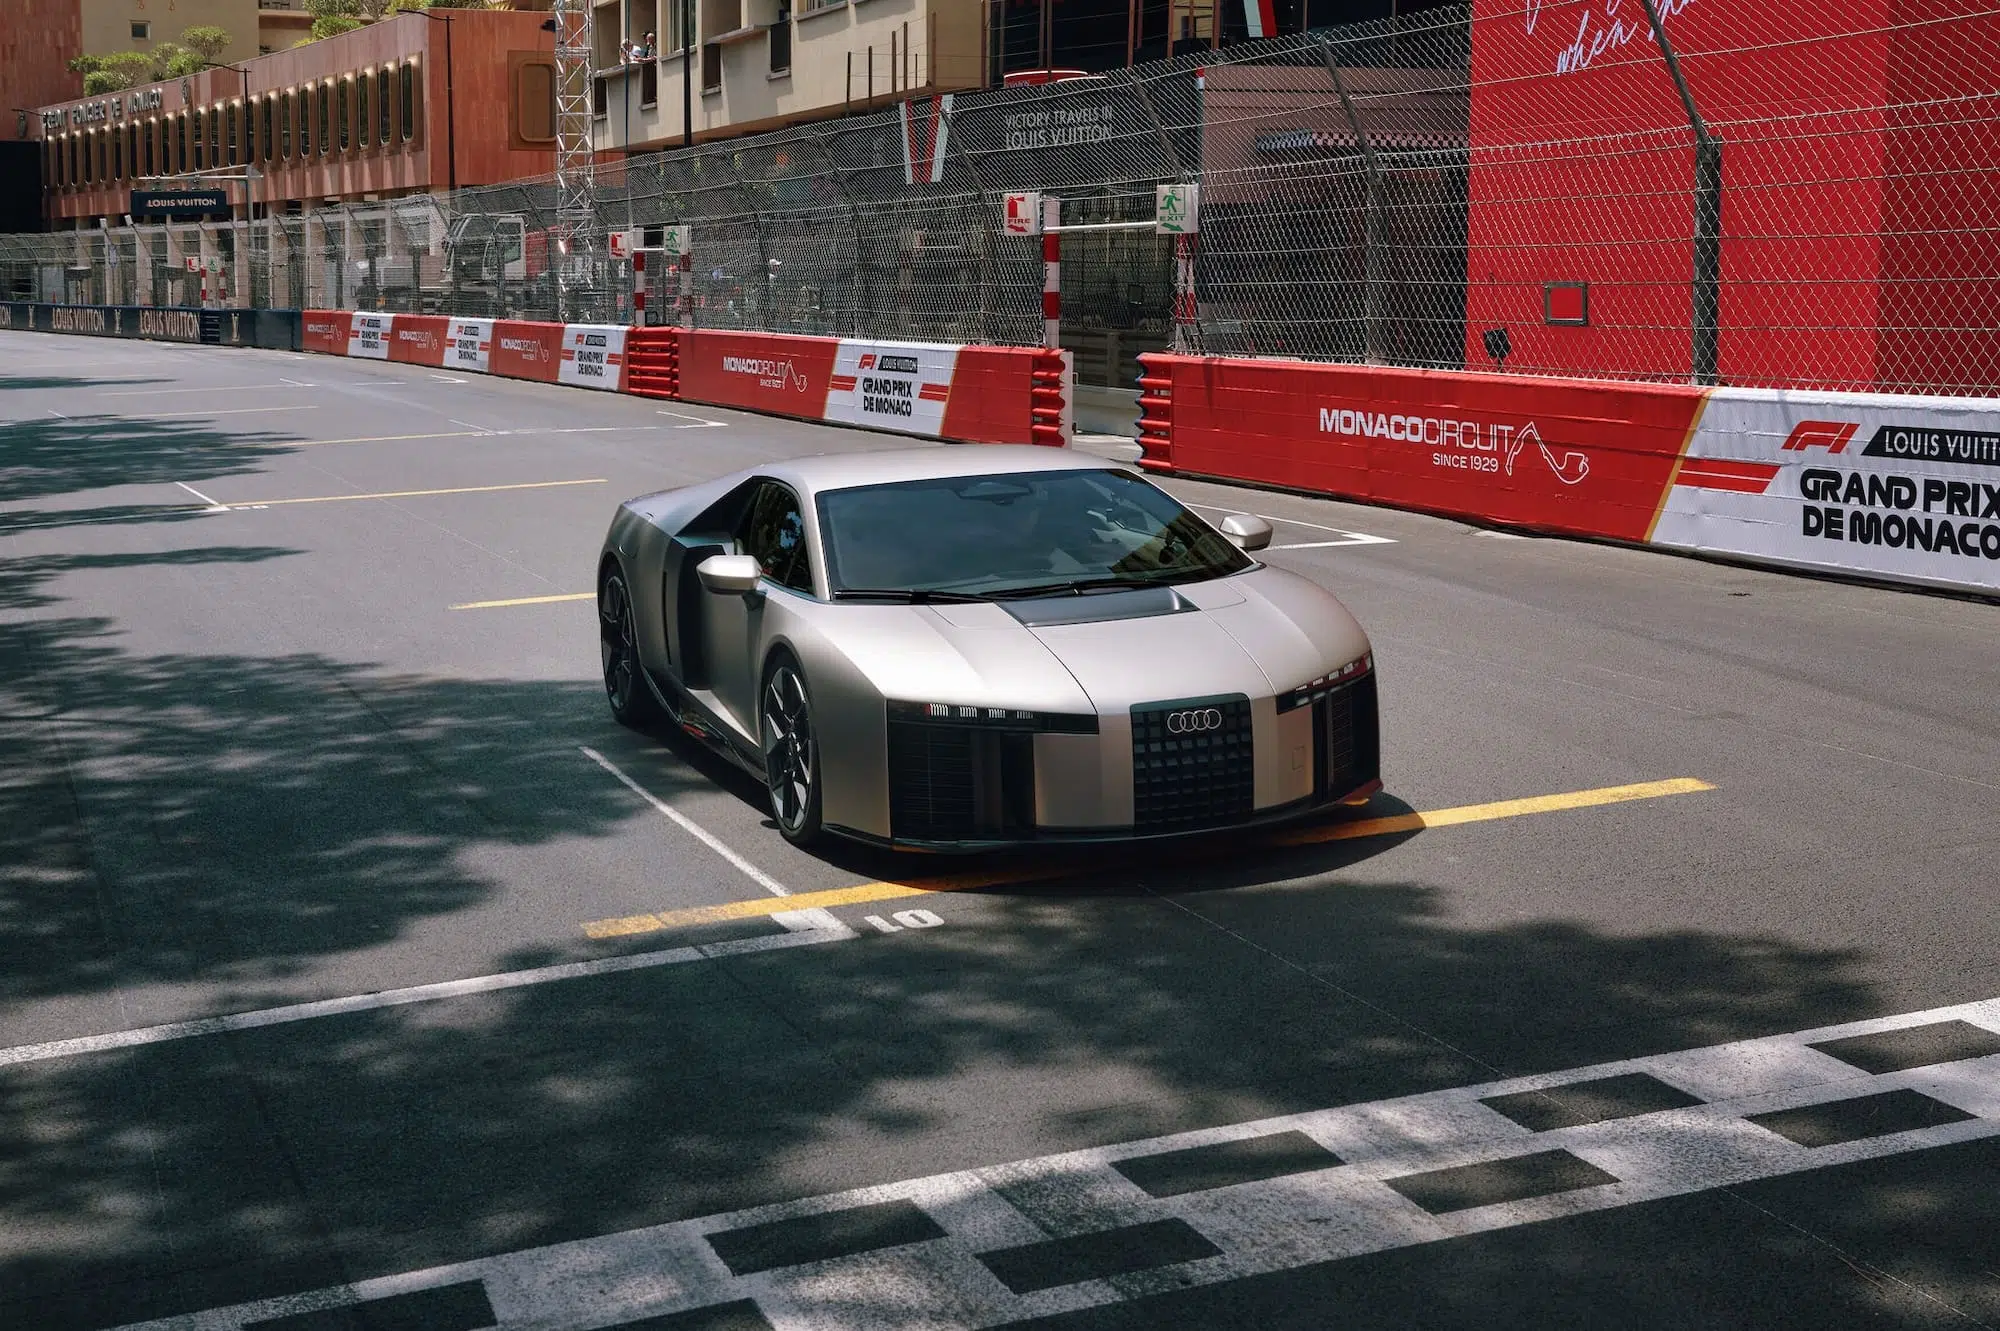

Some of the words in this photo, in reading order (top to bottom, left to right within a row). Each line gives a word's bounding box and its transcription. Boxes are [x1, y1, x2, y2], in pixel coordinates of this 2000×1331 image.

[1556, 10, 1638, 76] when
[111, 98, 121, 118] DE
[127, 91, 161, 113] MONACO
[1005, 112, 1049, 128] VICTORY
[1053, 108, 1098, 125] TRAVELS
[1101, 105, 1113, 121] IN
[1005, 129, 1047, 149] LOUIS
[1051, 126, 1113, 146] VUITTON
[146, 199, 176, 208] LOUIS
[177, 198, 217, 207] VUITTON
[52, 308, 74, 330] LOUIS
[74, 309, 105, 332] VUITTON
[139, 310, 164, 335] LOUIS
[164, 312, 200, 338] VUITTON
[863, 377, 892, 395] GRAND
[892, 380, 913, 398] PRIX
[863, 396, 875, 412] DE
[875, 398, 912, 417] MONACO
[1884, 430, 1940, 457] LOUIS
[1945, 434, 2000, 461] VUITT
[1432, 453, 1468, 469] SINCE
[1470, 455, 1499, 472] 1929
[1800, 468, 1917, 510] GRAND
[1923, 479, 2000, 519] PRIX
[1803, 505, 1843, 540] DE
[1849, 510, 2000, 560] MONACO
